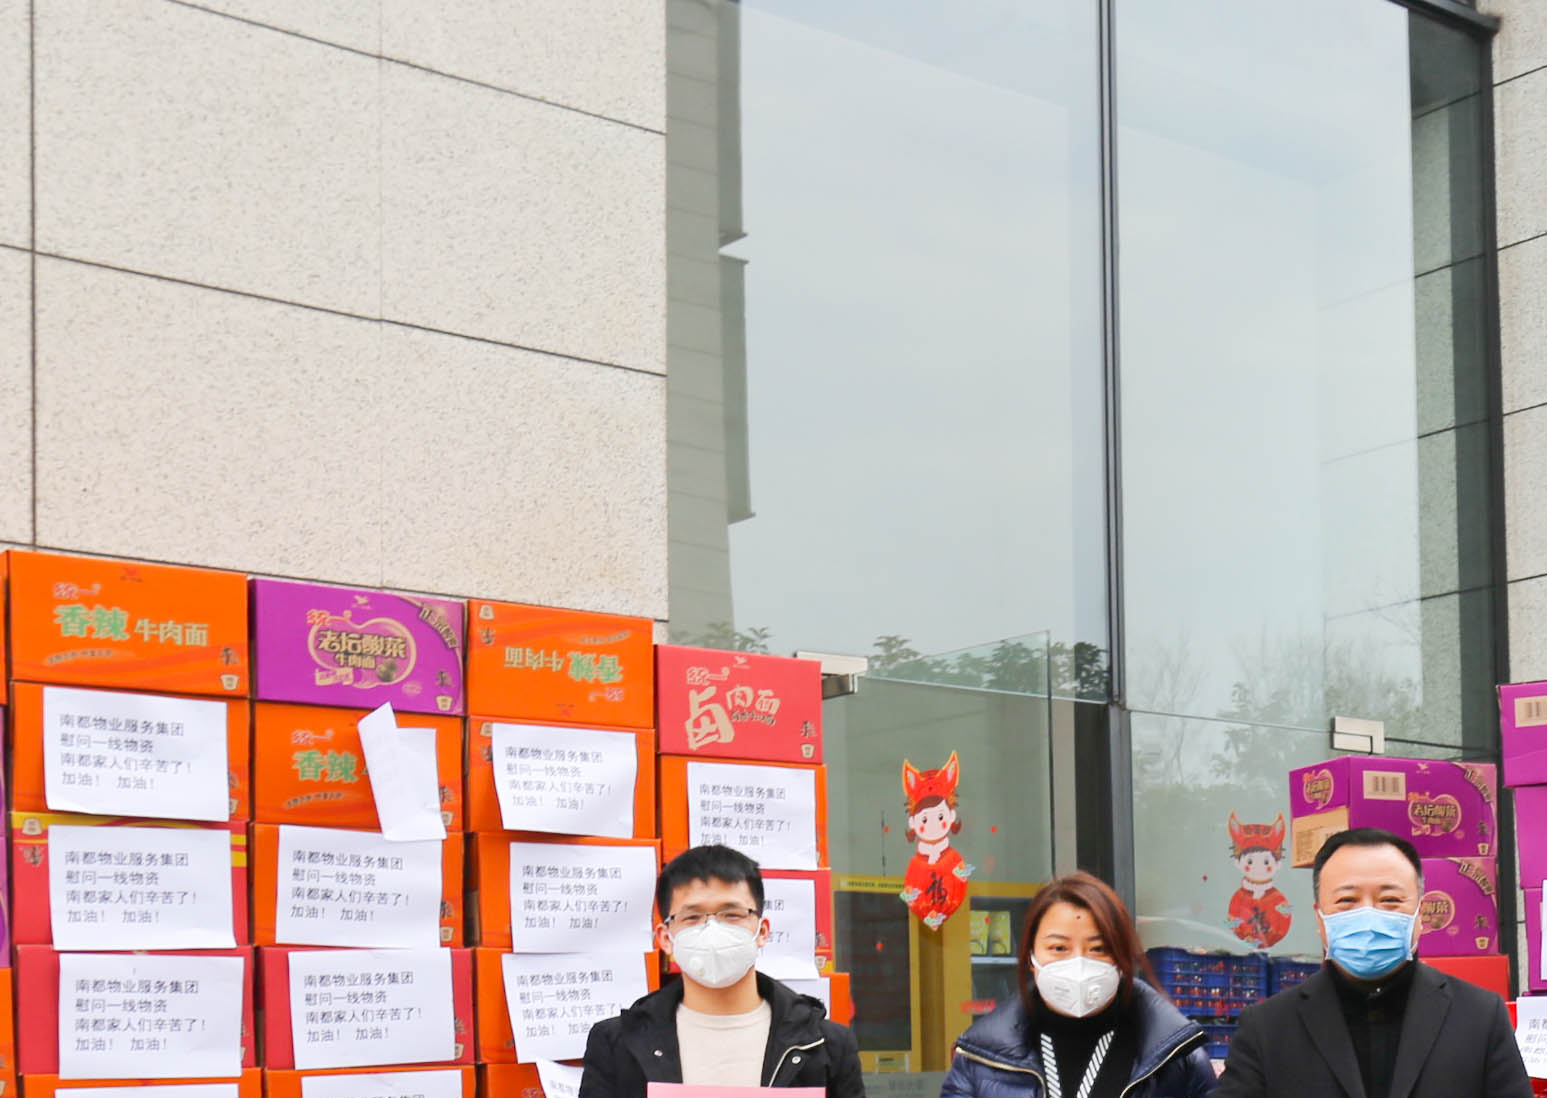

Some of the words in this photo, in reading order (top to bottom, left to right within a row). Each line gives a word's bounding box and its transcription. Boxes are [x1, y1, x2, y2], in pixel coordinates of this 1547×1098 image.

[54, 605, 130, 641] 香辣
[134, 618, 209, 647] 牛肉面
[317, 630, 407, 658] 老坛酸菜
[334, 653, 377, 670] 牛肉面
[685, 684, 781, 751] 卤肉面
[292, 751, 359, 783] 香辣
[293, 848, 403, 870] 南都物业服务集团
[292, 868, 375, 886] 慰问一线物资
[292, 886, 408, 906] 南都家人们辛苦了！
[291, 904, 325, 919] 加油！
[340, 908, 374, 922] 加油！
[75, 978, 199, 994] 南都物业服务集团
[75, 998, 167, 1013] 慰问一线物资
[75, 1017, 205, 1032] 南都家人们辛苦了！
[75, 1037, 112, 1051] 加油！
[131, 1037, 166, 1051] 加油！
